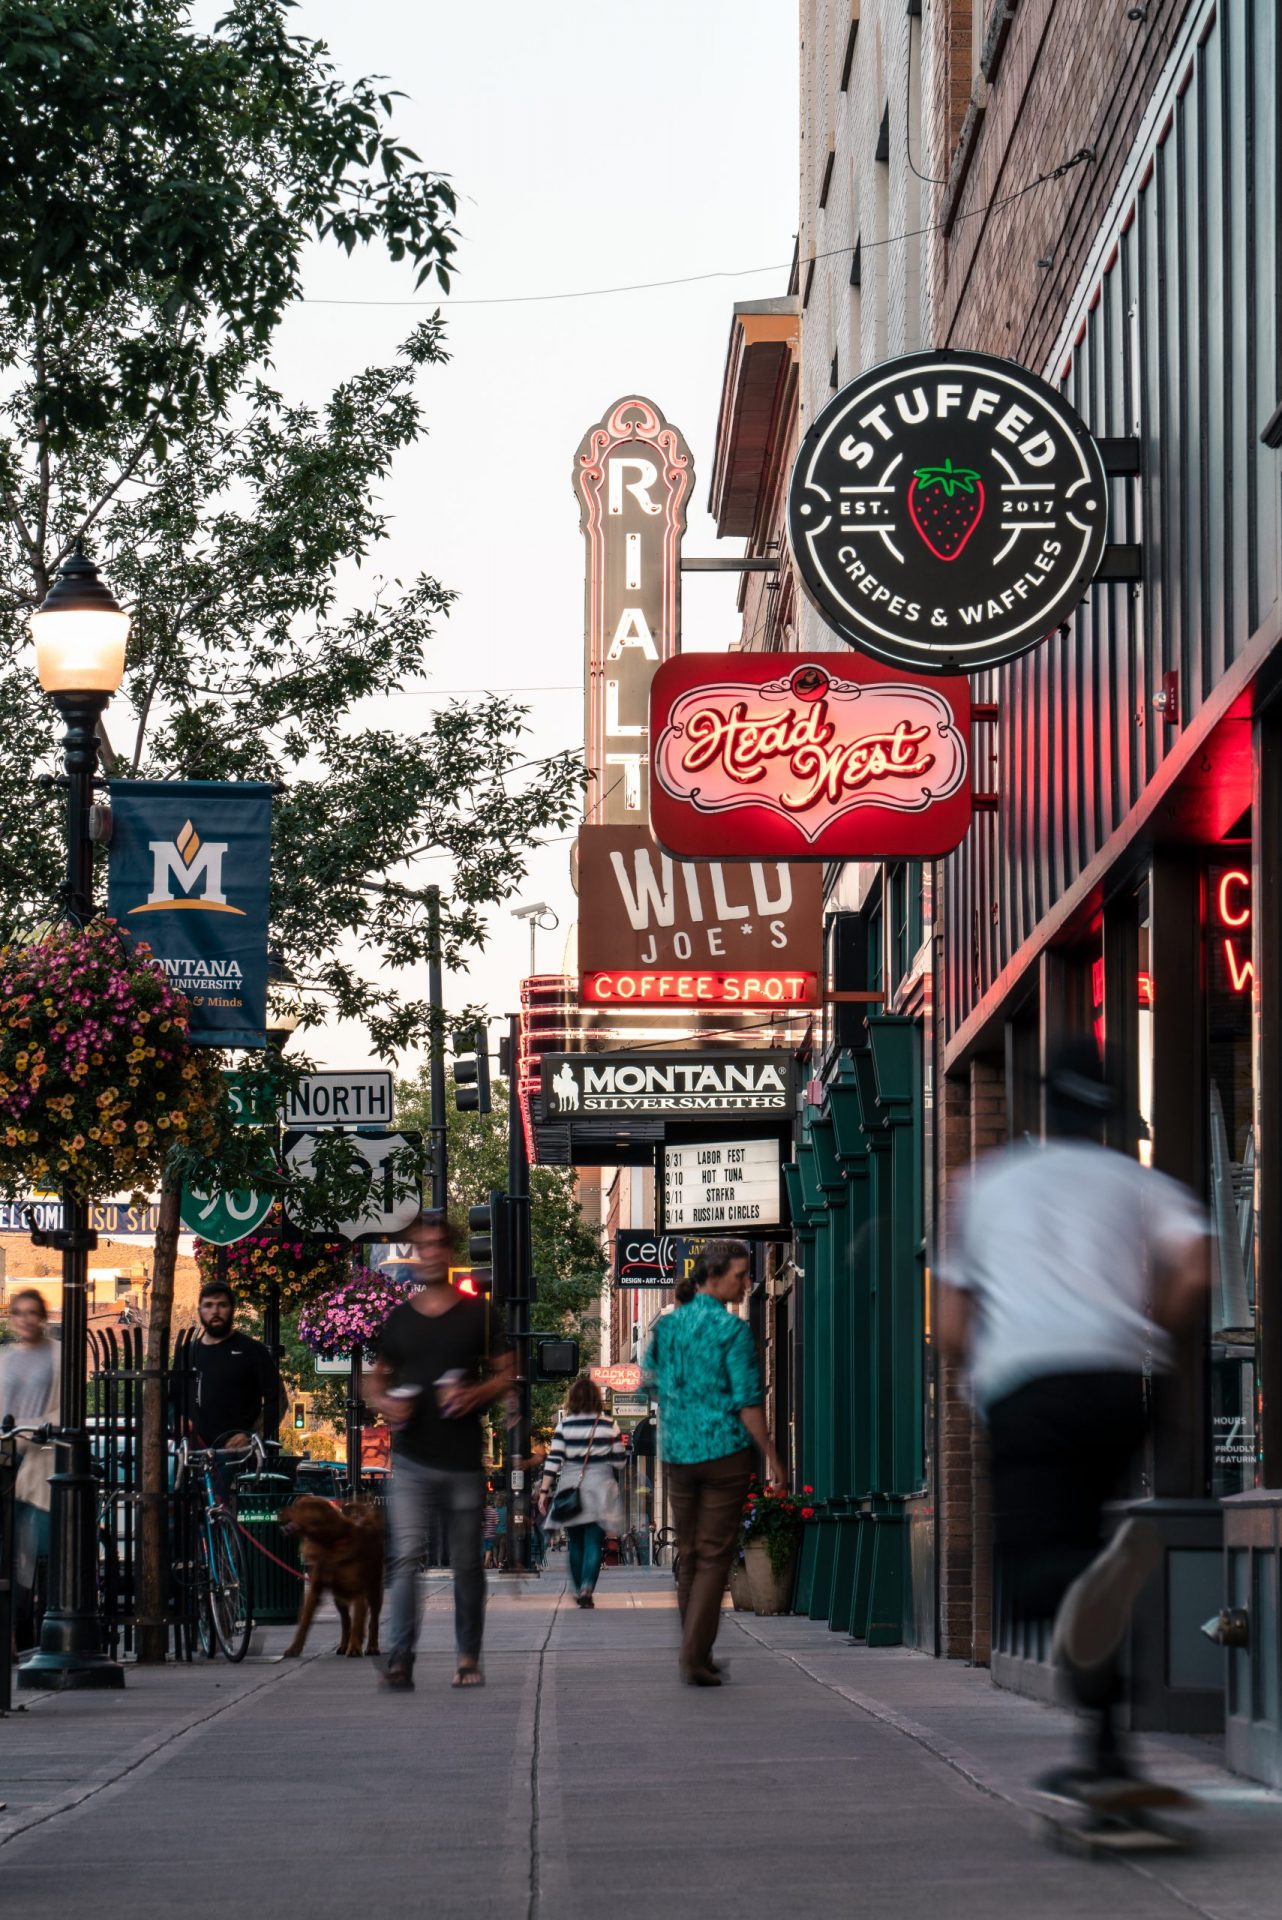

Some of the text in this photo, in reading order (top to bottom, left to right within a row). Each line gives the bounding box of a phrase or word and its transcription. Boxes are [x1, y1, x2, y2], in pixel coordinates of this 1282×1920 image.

[838, 384, 1057, 469] STUFFED
[840, 500, 1054, 516] EST. 2017
[837, 538, 1062, 626] CREPES & WAFFLES
[606, 457, 662, 811] RIALT
[681, 699, 936, 814] Head West
[609, 848, 793, 930] WILD
[1220, 871, 1250, 926] C
[150, 959, 243, 977] ONTANA
[169, 979, 243, 990] UNIVERSITY
[595, 976, 805, 1000] COFFEE SPOT
[208, 997, 242, 1007] Minds
[583, 1064, 786, 1092] MONTANA
[291, 1082, 385, 1116] NORTH
[583, 1097, 786, 1110] SILVERSMITHS
[665, 1148, 745, 1168] 8/31 LABOR FEST
[665, 1168, 743, 1186] 9/10 HOT TUNA
[665, 1187, 735, 1204] 9/11 STRFKR
[0, 1206, 64, 1230] ELCOM
[88, 1206, 118, 1231] SU
[665, 1205, 760, 1223] 9/14 RUSSIAN CIRCLES
[1213, 1416, 1247, 1425] HOURS
[1215, 1445, 1255, 1453] PROUDLY
[1215, 1455, 1257, 1463] FEATURIN
